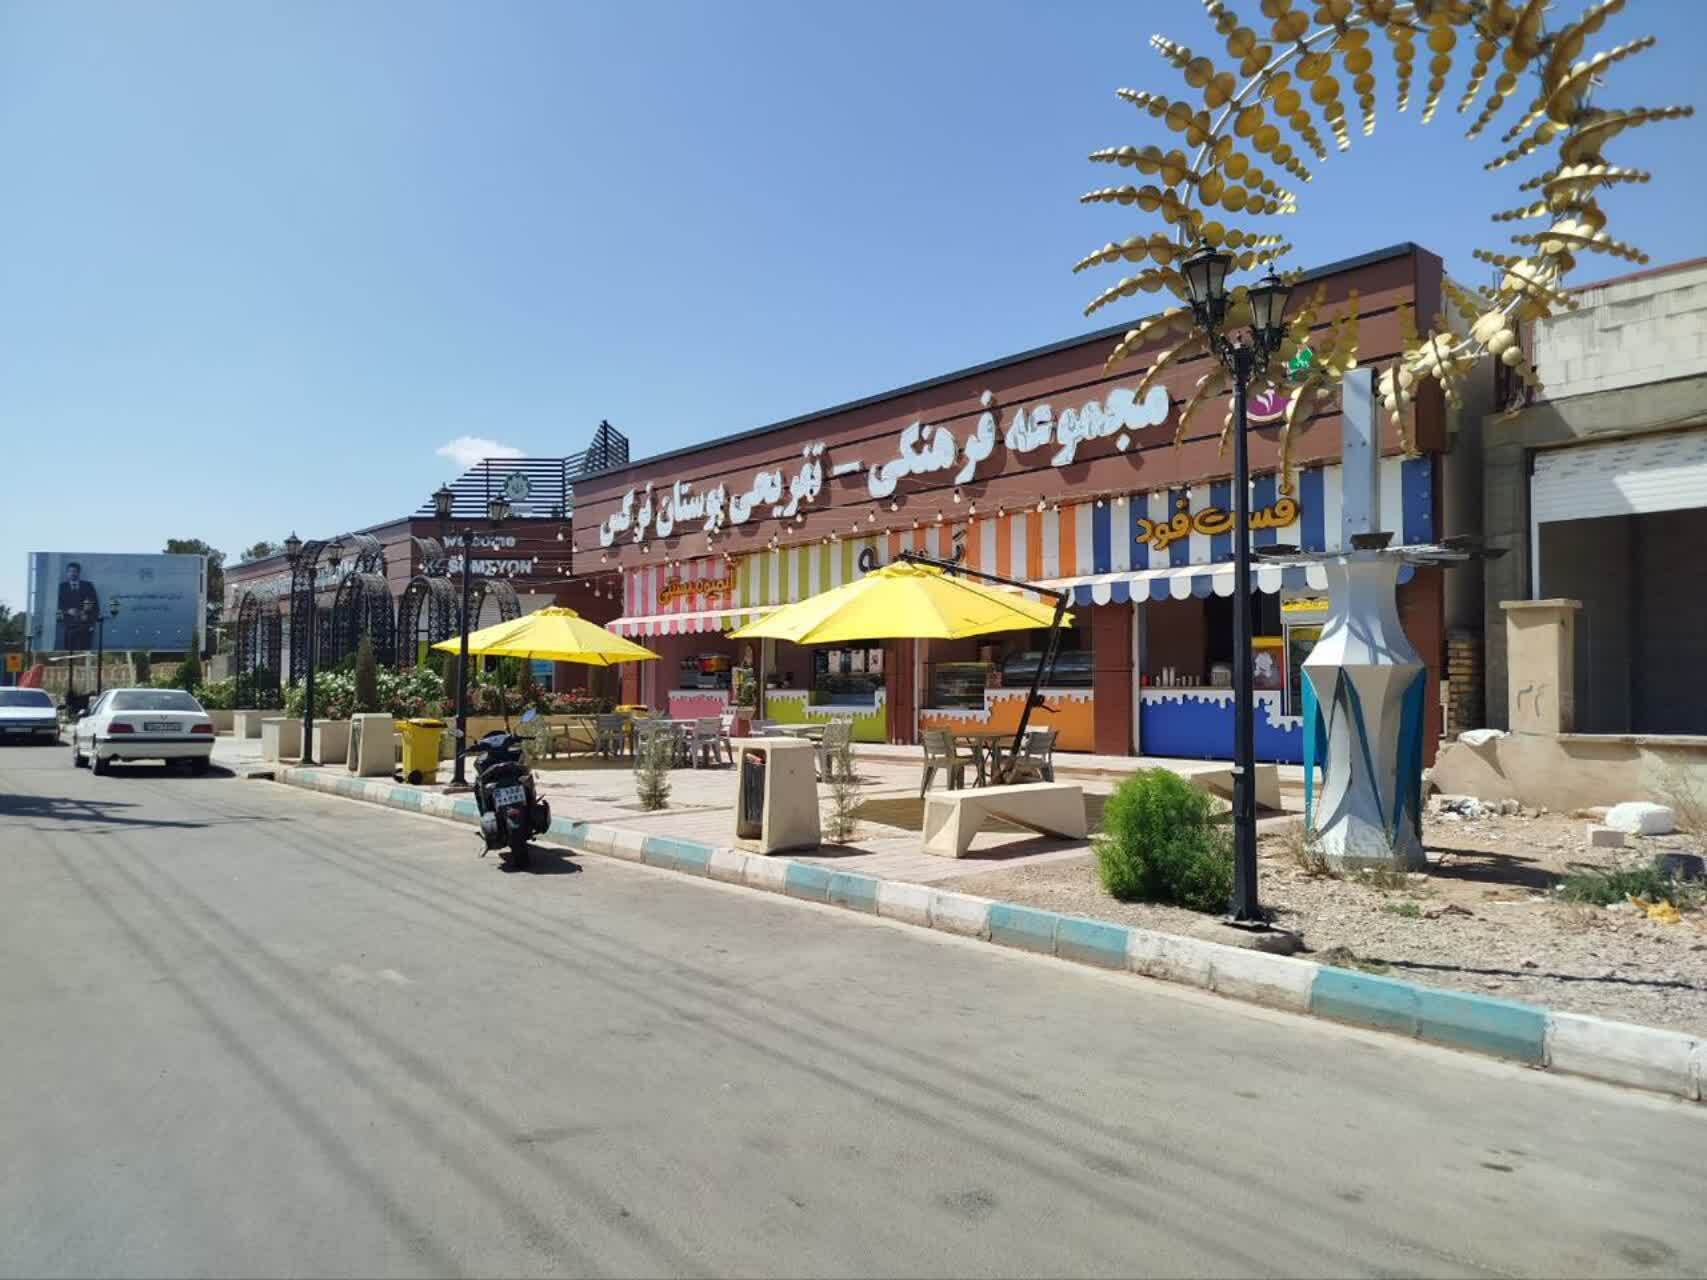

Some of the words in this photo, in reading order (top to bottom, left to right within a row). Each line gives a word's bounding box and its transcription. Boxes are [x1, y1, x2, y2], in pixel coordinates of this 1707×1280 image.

[867, 389, 997, 498] فرهنگی
[1005, 385, 1171, 467] مجموعه
[656, 479, 725, 538] بوستان
[729, 442, 826, 524] تفریحی
[1193, 484, 1299, 536] فست
[1134, 496, 1193, 551] فود
